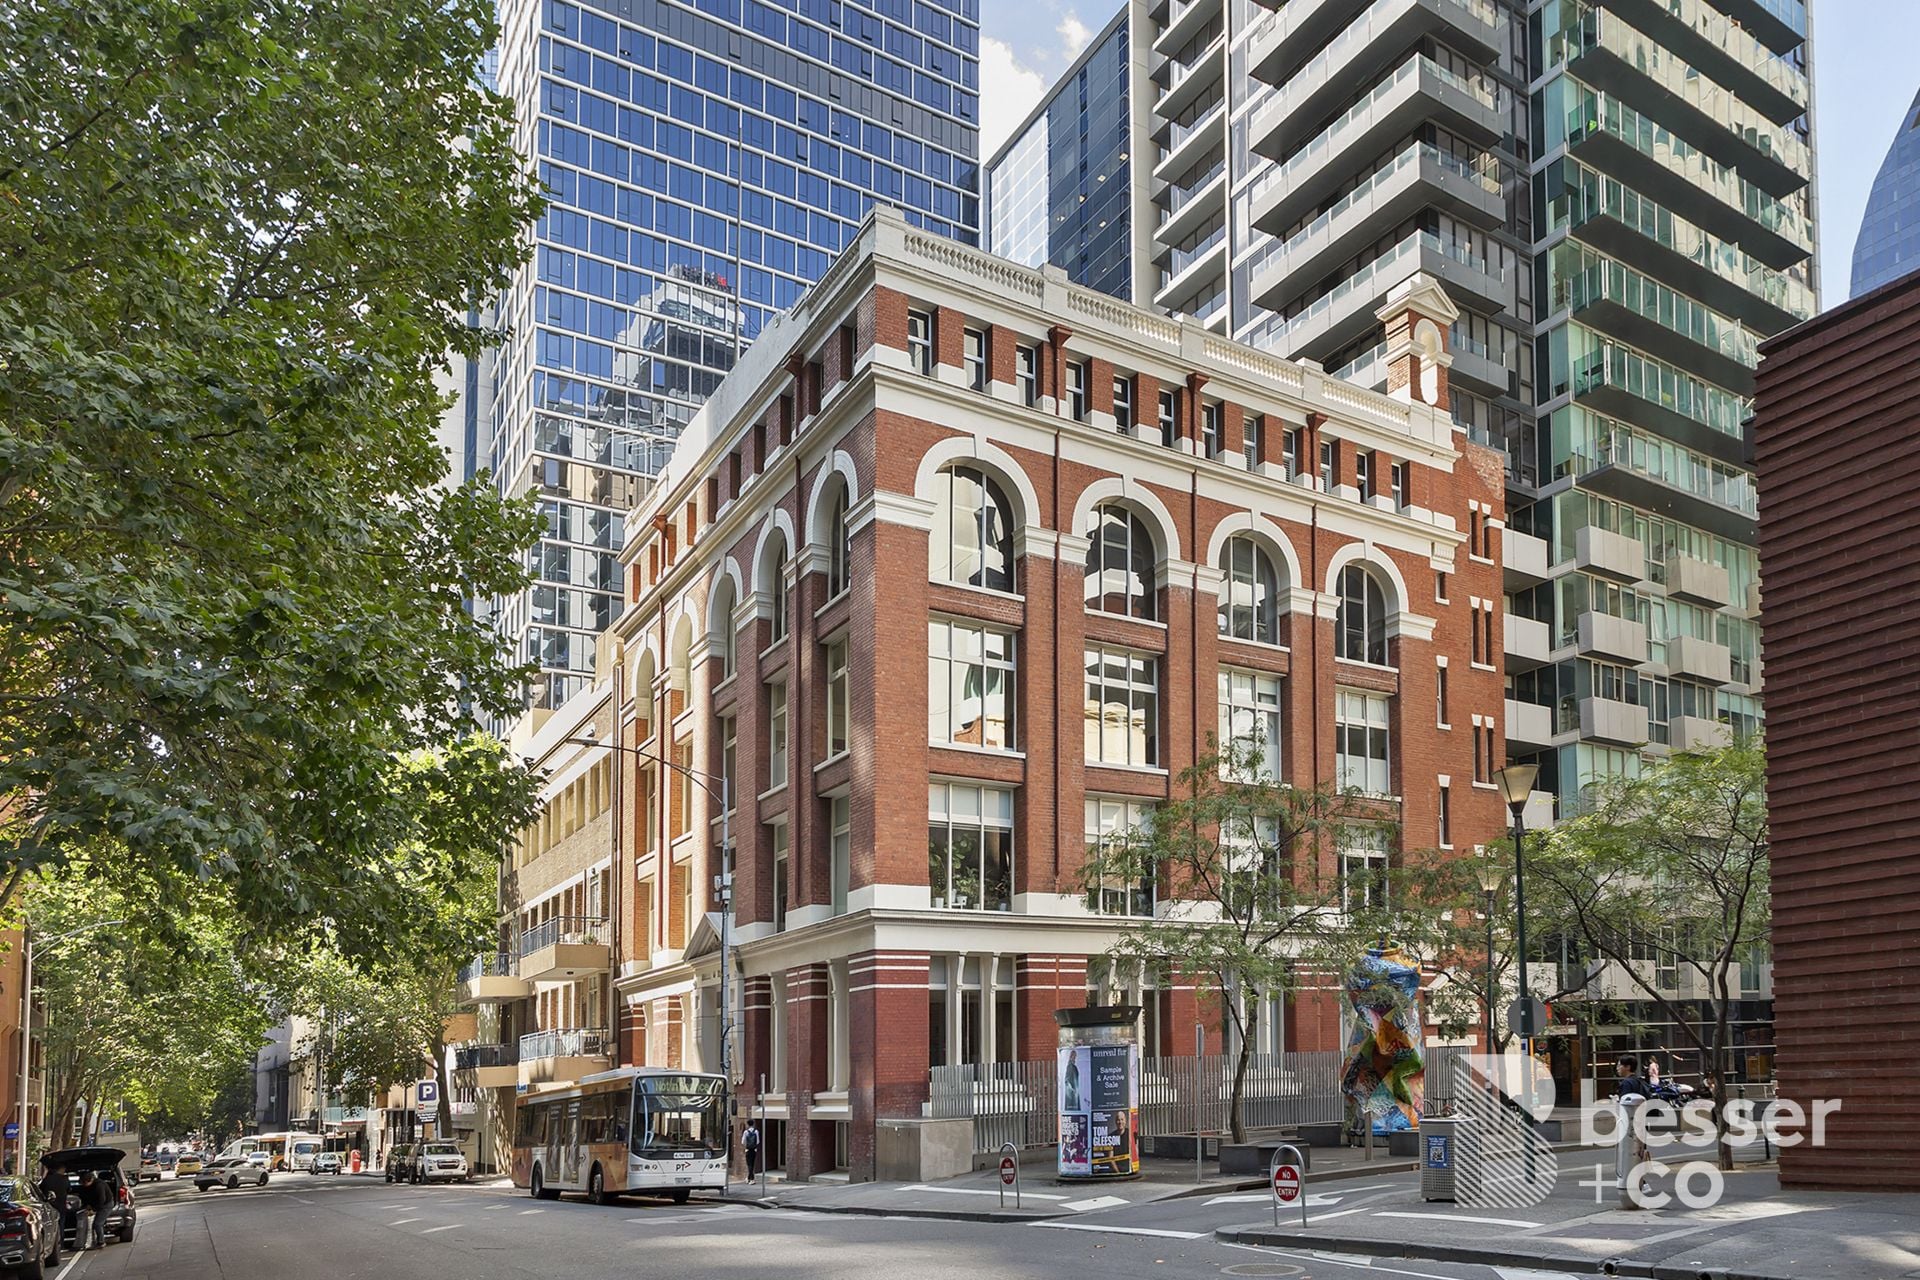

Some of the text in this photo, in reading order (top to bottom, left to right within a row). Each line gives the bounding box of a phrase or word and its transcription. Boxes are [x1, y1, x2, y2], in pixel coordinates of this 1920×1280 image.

[1100, 1066, 1122, 1074] Sample
[1103, 1074, 1125, 1082] Archive
[422, 1085, 433, 1098] P
[105, 1121, 114, 1131] P
[1093, 1127, 1108, 1136] TOM
[1093, 1136, 1120, 1146] GLEESON
[1282, 1170, 1291, 1179] NO
[1278, 1188, 1297, 1196] ENTRY
